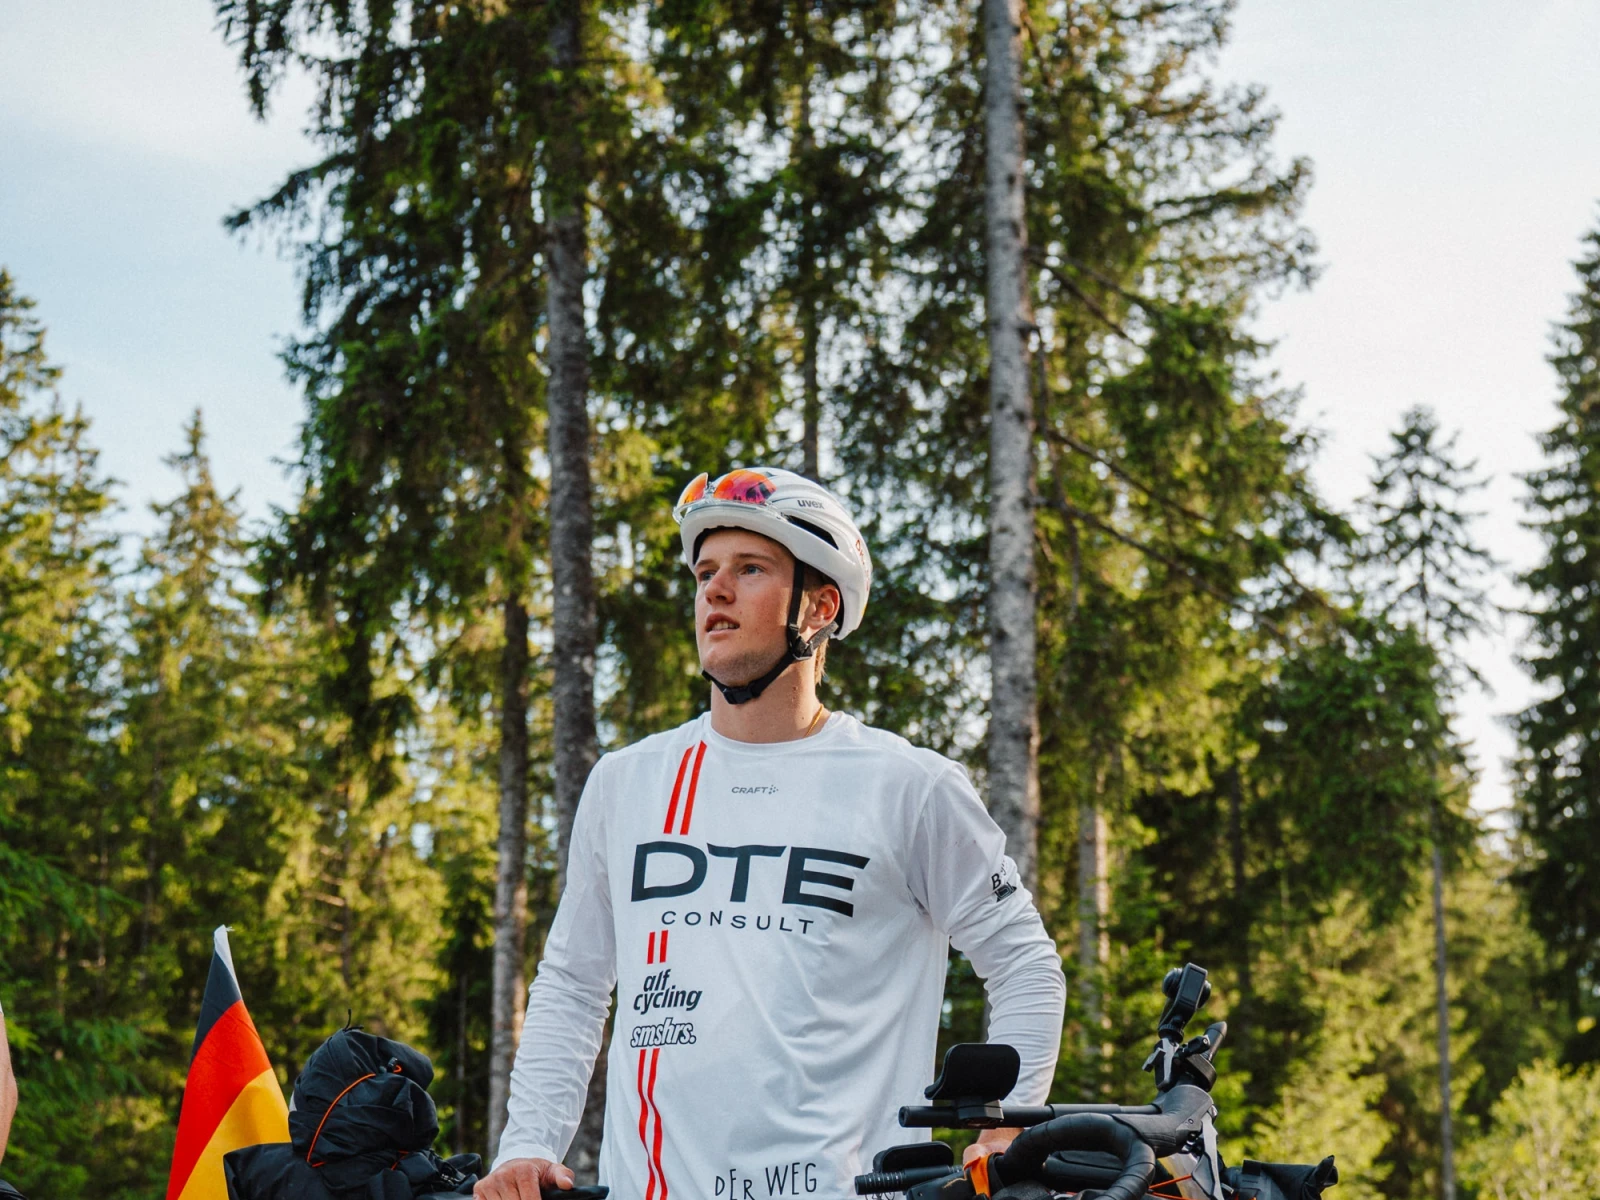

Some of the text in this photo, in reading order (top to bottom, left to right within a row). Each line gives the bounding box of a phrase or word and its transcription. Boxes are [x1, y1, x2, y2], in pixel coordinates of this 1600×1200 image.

[797, 499, 825, 510] uvex
[731, 786, 767, 794] CRAFT
[630, 840, 871, 918] DTE
[661, 910, 814, 934] CONSULT
[643, 968, 672, 992] alf
[633, 984, 703, 1015] cycling
[765, 1162, 817, 1197] WEG
